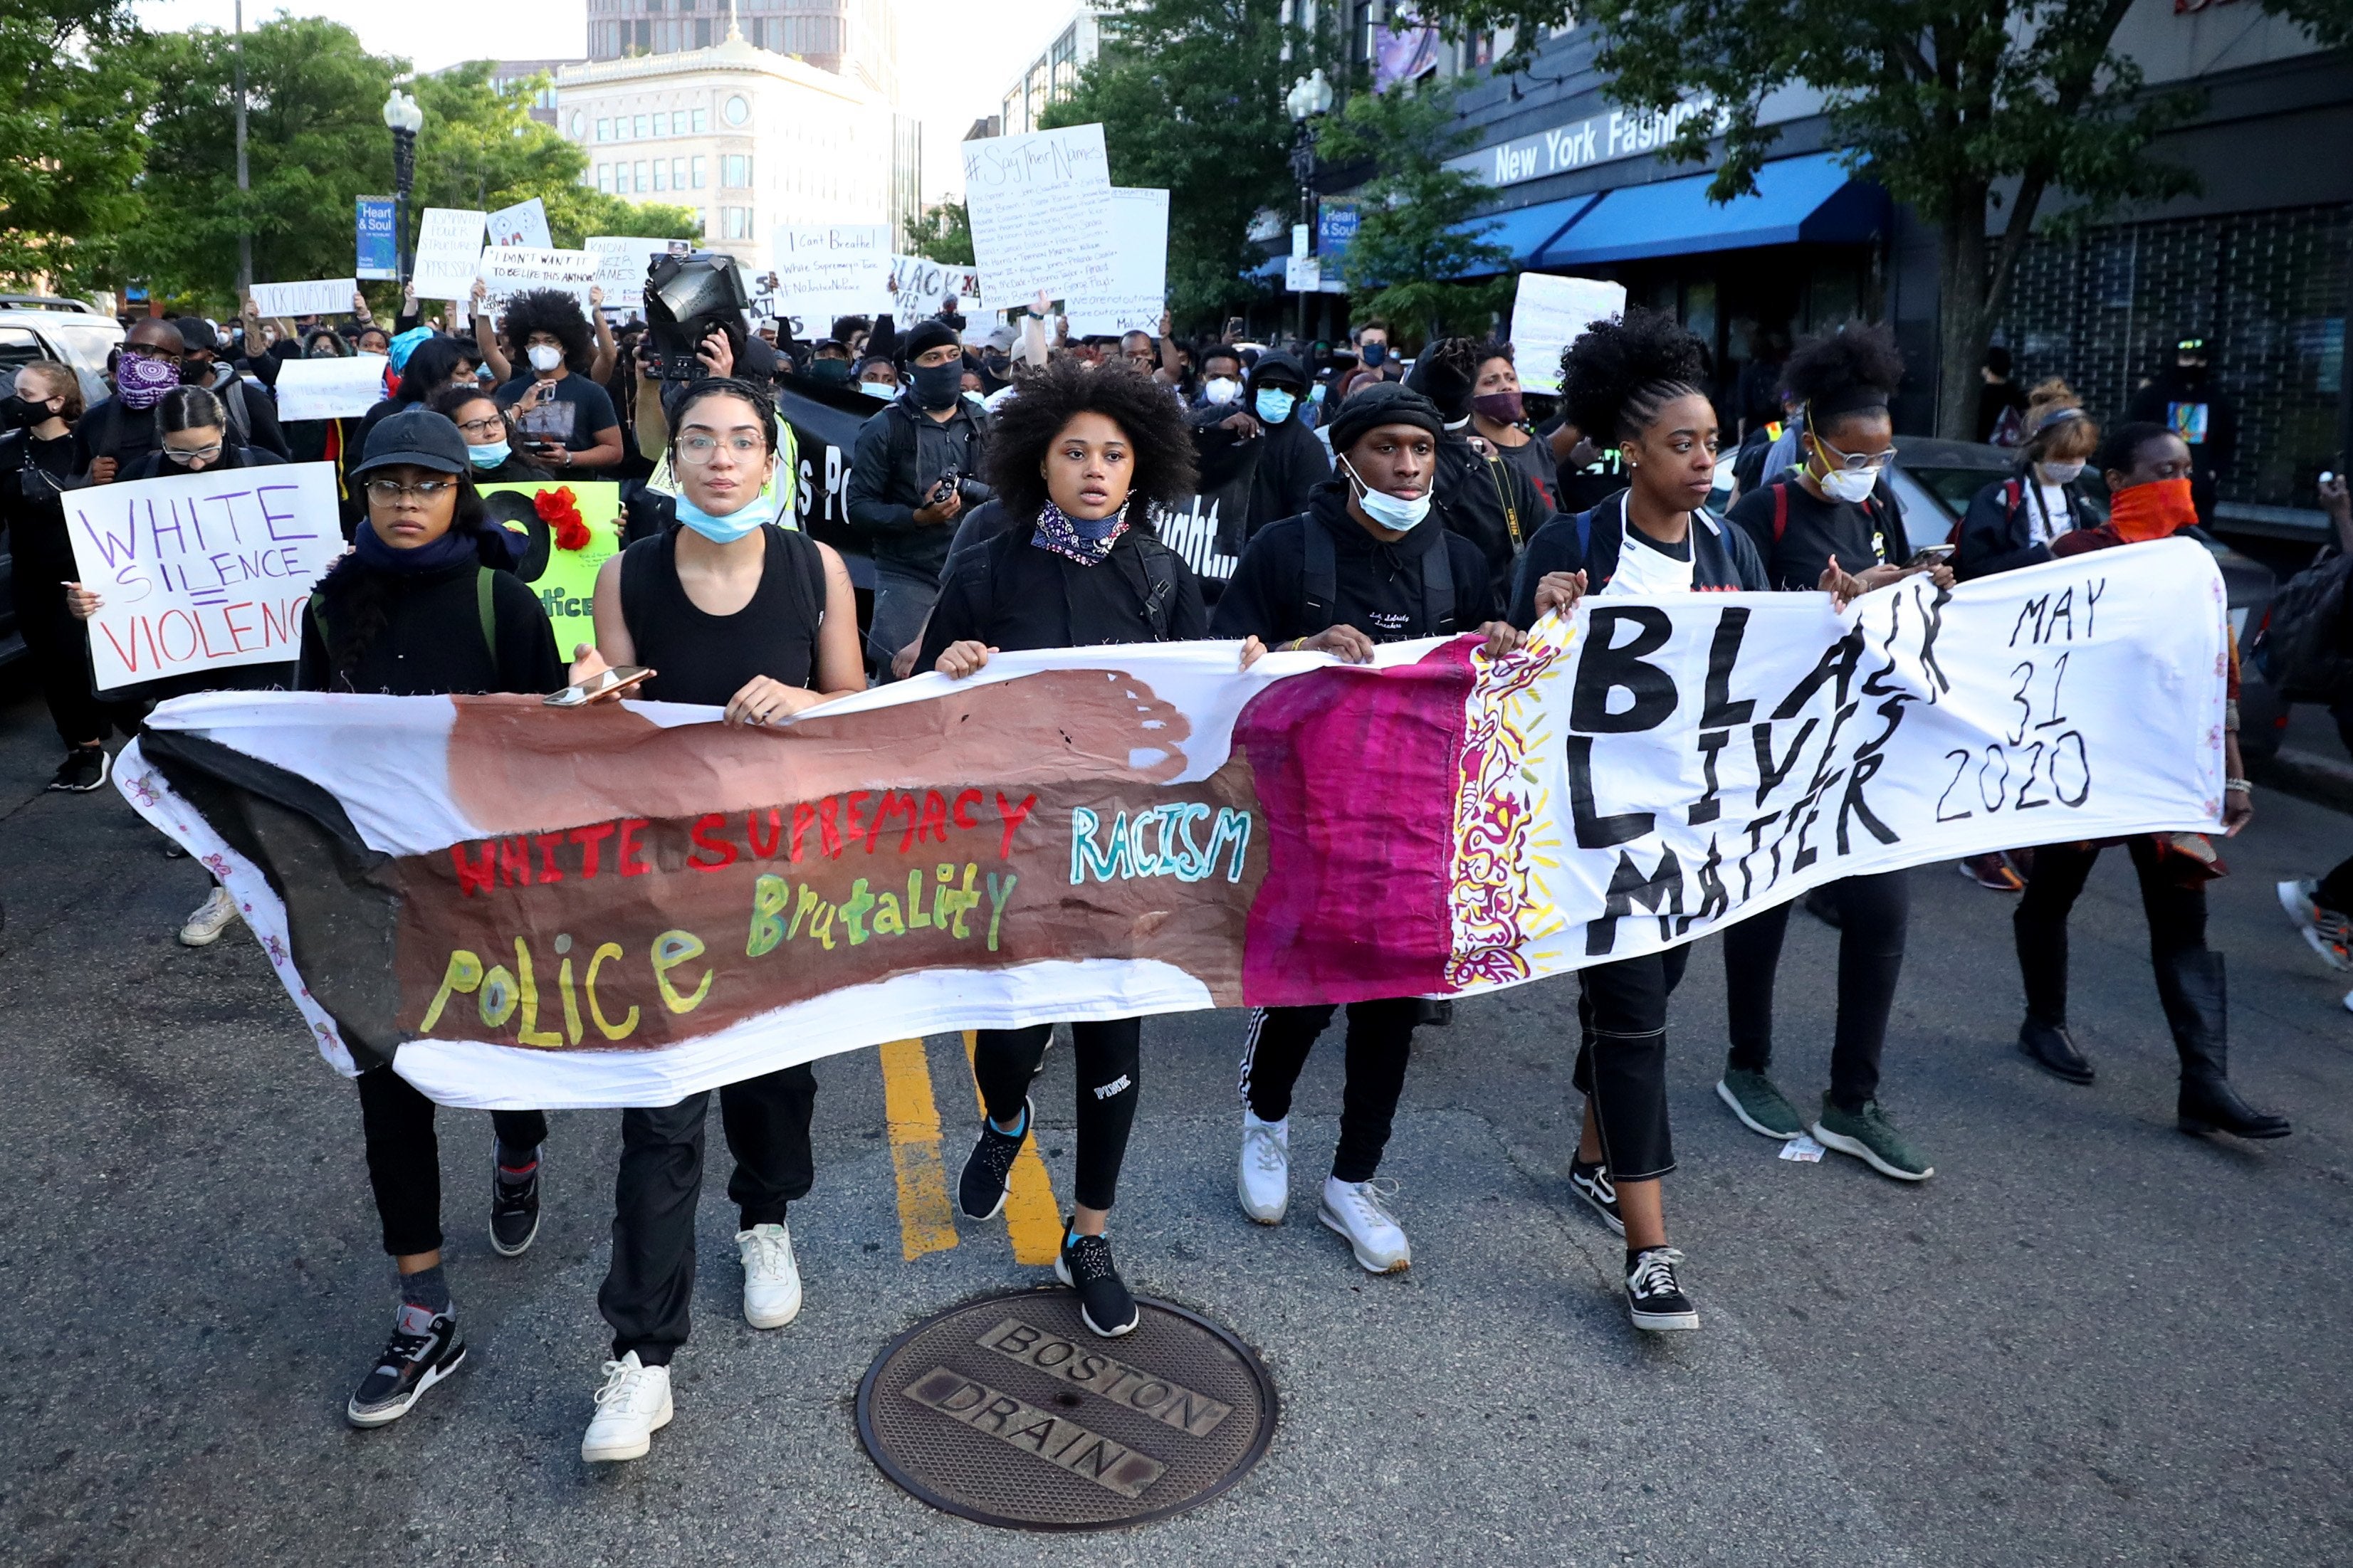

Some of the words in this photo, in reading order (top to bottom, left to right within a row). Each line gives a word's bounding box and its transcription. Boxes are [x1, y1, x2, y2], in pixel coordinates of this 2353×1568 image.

[1495, 144, 1537, 183] New
[1546, 121, 1597, 170] York
[358, 218, 367, 231] &
[368, 218, 392, 231] Soul
[362, 206, 392, 219] Heart
[790, 231, 795, 252] I
[799, 233, 824, 248] Can't
[291, 283, 320, 312] LIVES
[540, 253, 573, 266] WANT
[782, 263, 811, 275] White
[1146, 314, 1159, 327] X
[77, 485, 319, 569] WHITE
[1155, 494, 1239, 580] ight...
[1507, 507, 1519, 536] Nikon
[115, 547, 312, 604] SILENCE
[100, 595, 310, 672] VIOLENC
[1569, 584, 1952, 733] BLACK
[2008, 576, 2107, 648] MAY
[2006, 651, 2071, 747] 31
[1567, 690, 1922, 850] LIVES
[1935, 729, 2092, 824] 2020
[450, 818, 651, 898] WHITE
[686, 788, 1039, 875] SUPREMACY
[1069, 801, 1252, 886] RACISM
[1584, 752, 1900, 957] MATTER
[1093, 1073, 1131, 1100] PINK
[994, 1323, 1215, 1430] BOSTON
[936, 1382, 1128, 1479] DRAIN
